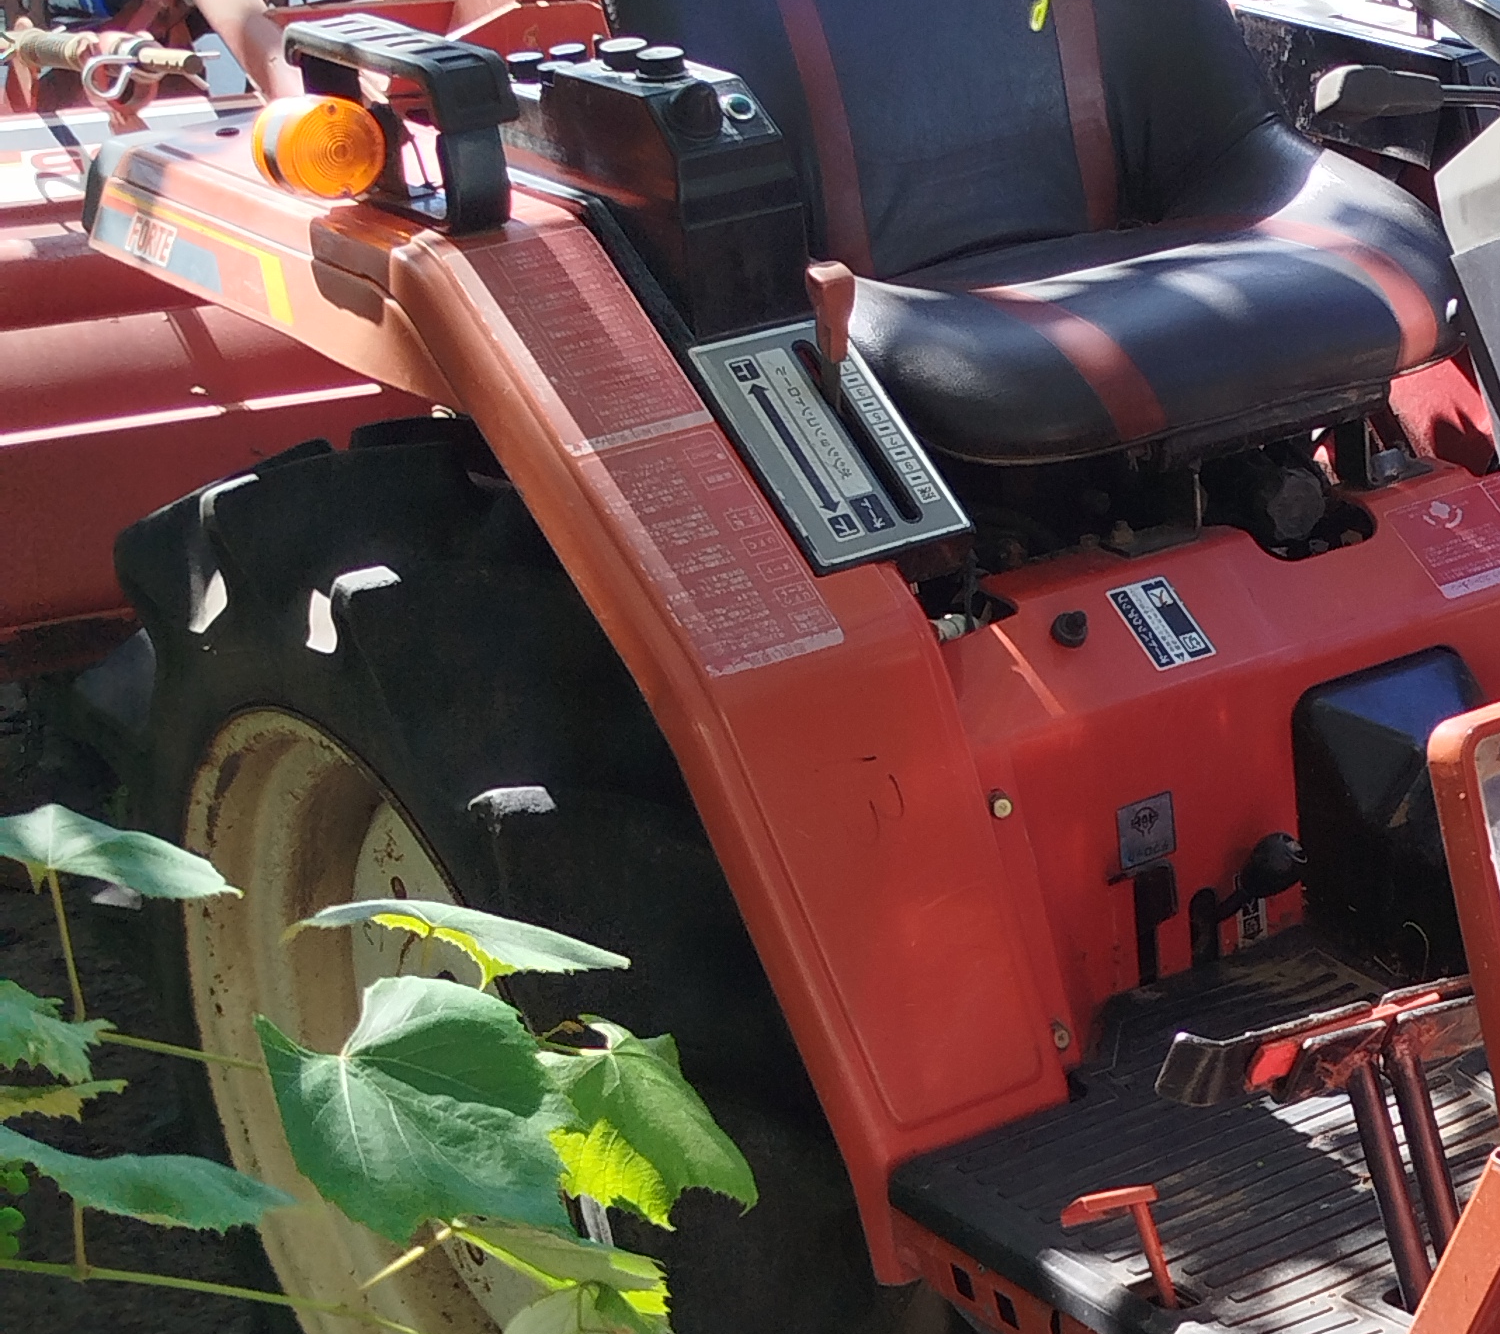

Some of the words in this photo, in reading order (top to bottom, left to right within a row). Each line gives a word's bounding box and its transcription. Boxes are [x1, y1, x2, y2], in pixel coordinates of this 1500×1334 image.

[126, 213, 177, 265] FORTE
[730, 359, 758, 381] 上
[830, 514, 858, 537] 下
